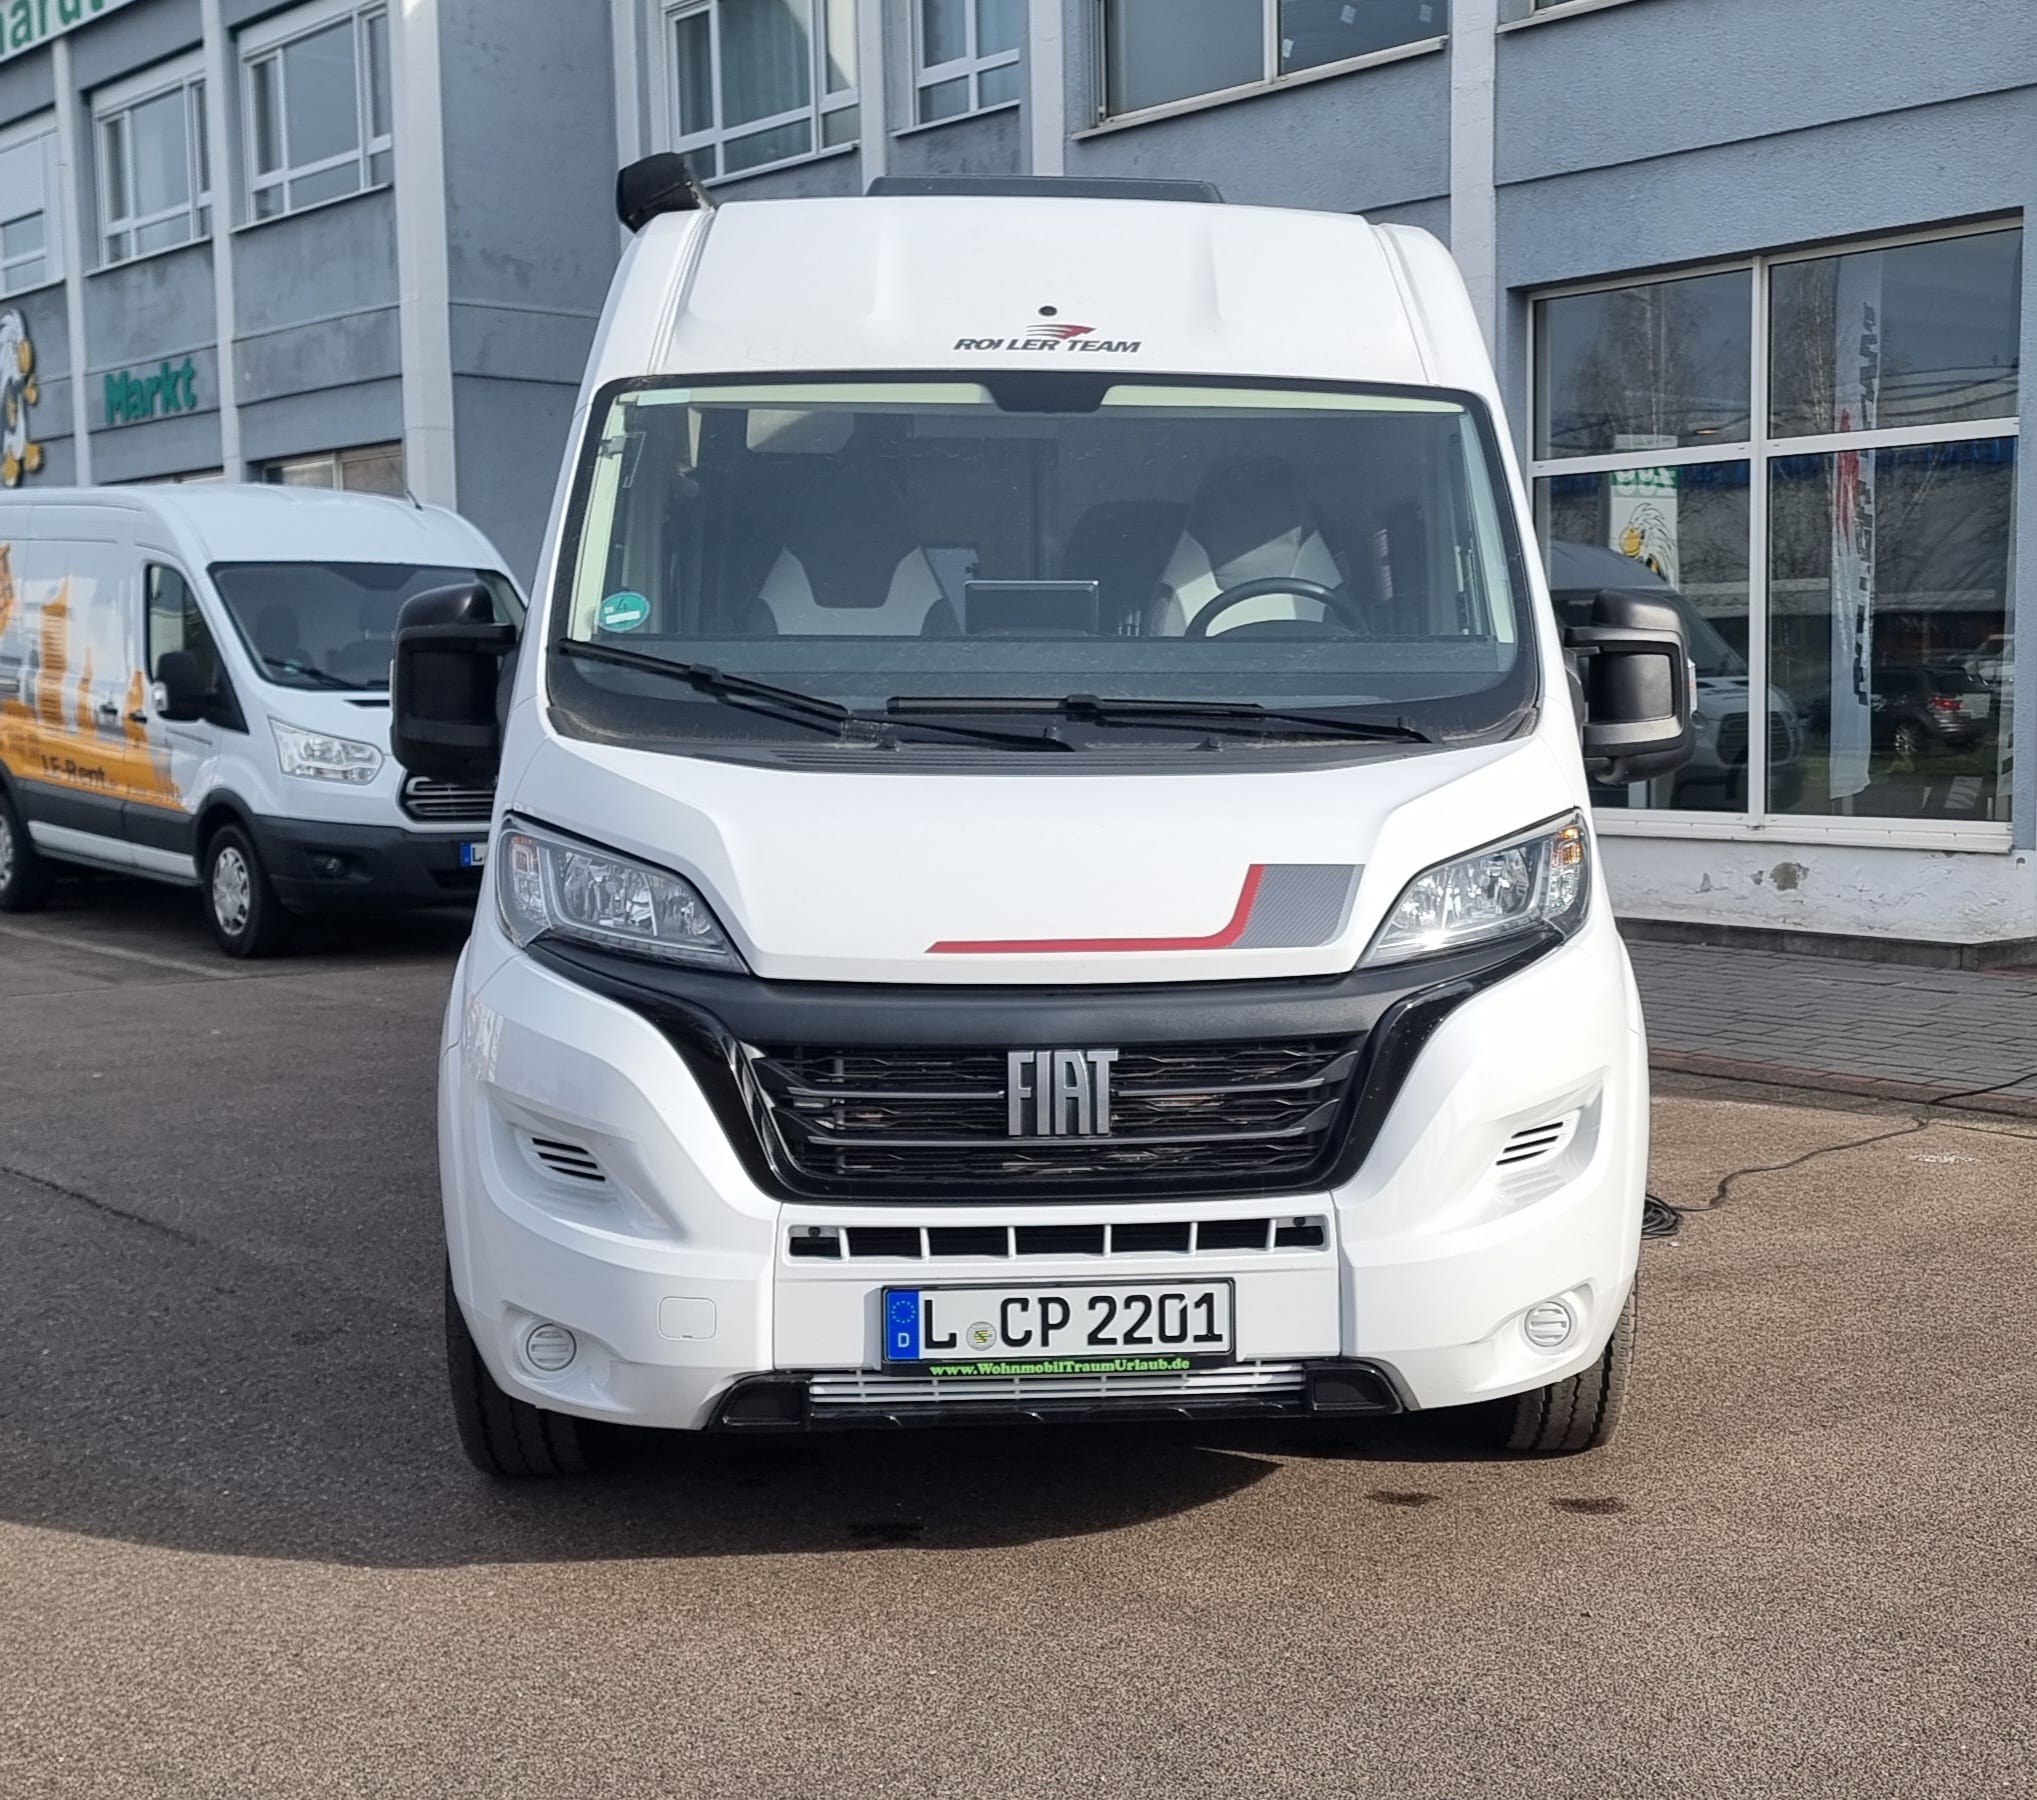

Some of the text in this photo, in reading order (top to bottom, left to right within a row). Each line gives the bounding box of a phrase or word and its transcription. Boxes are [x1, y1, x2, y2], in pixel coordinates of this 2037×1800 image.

[1067, 339, 1142, 353] TEAM
[104, 356, 196, 425] Markt
[1007, 1049, 1119, 1136] FIAT
[898, 1292, 1223, 1349] D L CP 2201
[929, 1358, 1190, 1377] www.WohnmobilTraumUrlaub.de
